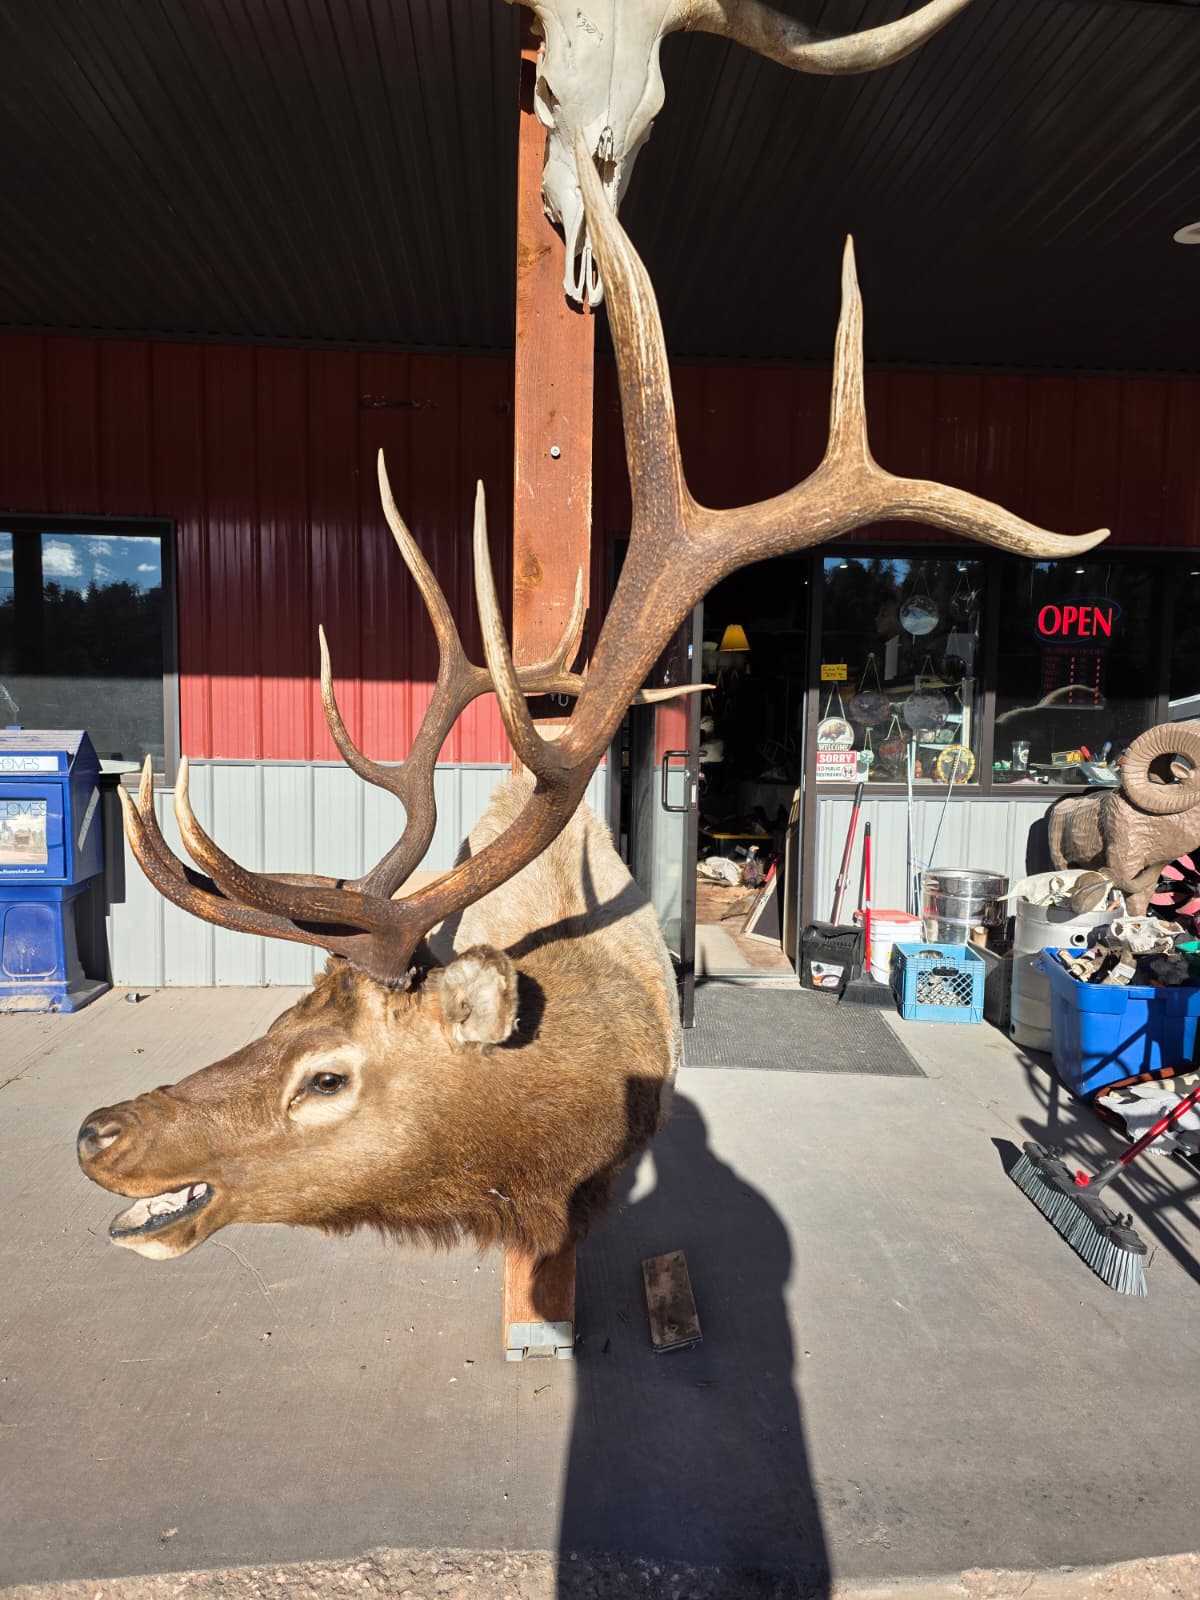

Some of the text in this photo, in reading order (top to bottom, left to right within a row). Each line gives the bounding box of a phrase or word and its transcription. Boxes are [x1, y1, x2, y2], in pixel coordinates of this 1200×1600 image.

[1038, 605, 1112, 636] OPEN
[818, 743, 849, 751] WELCOME
[819, 754, 852, 763] SORRY
